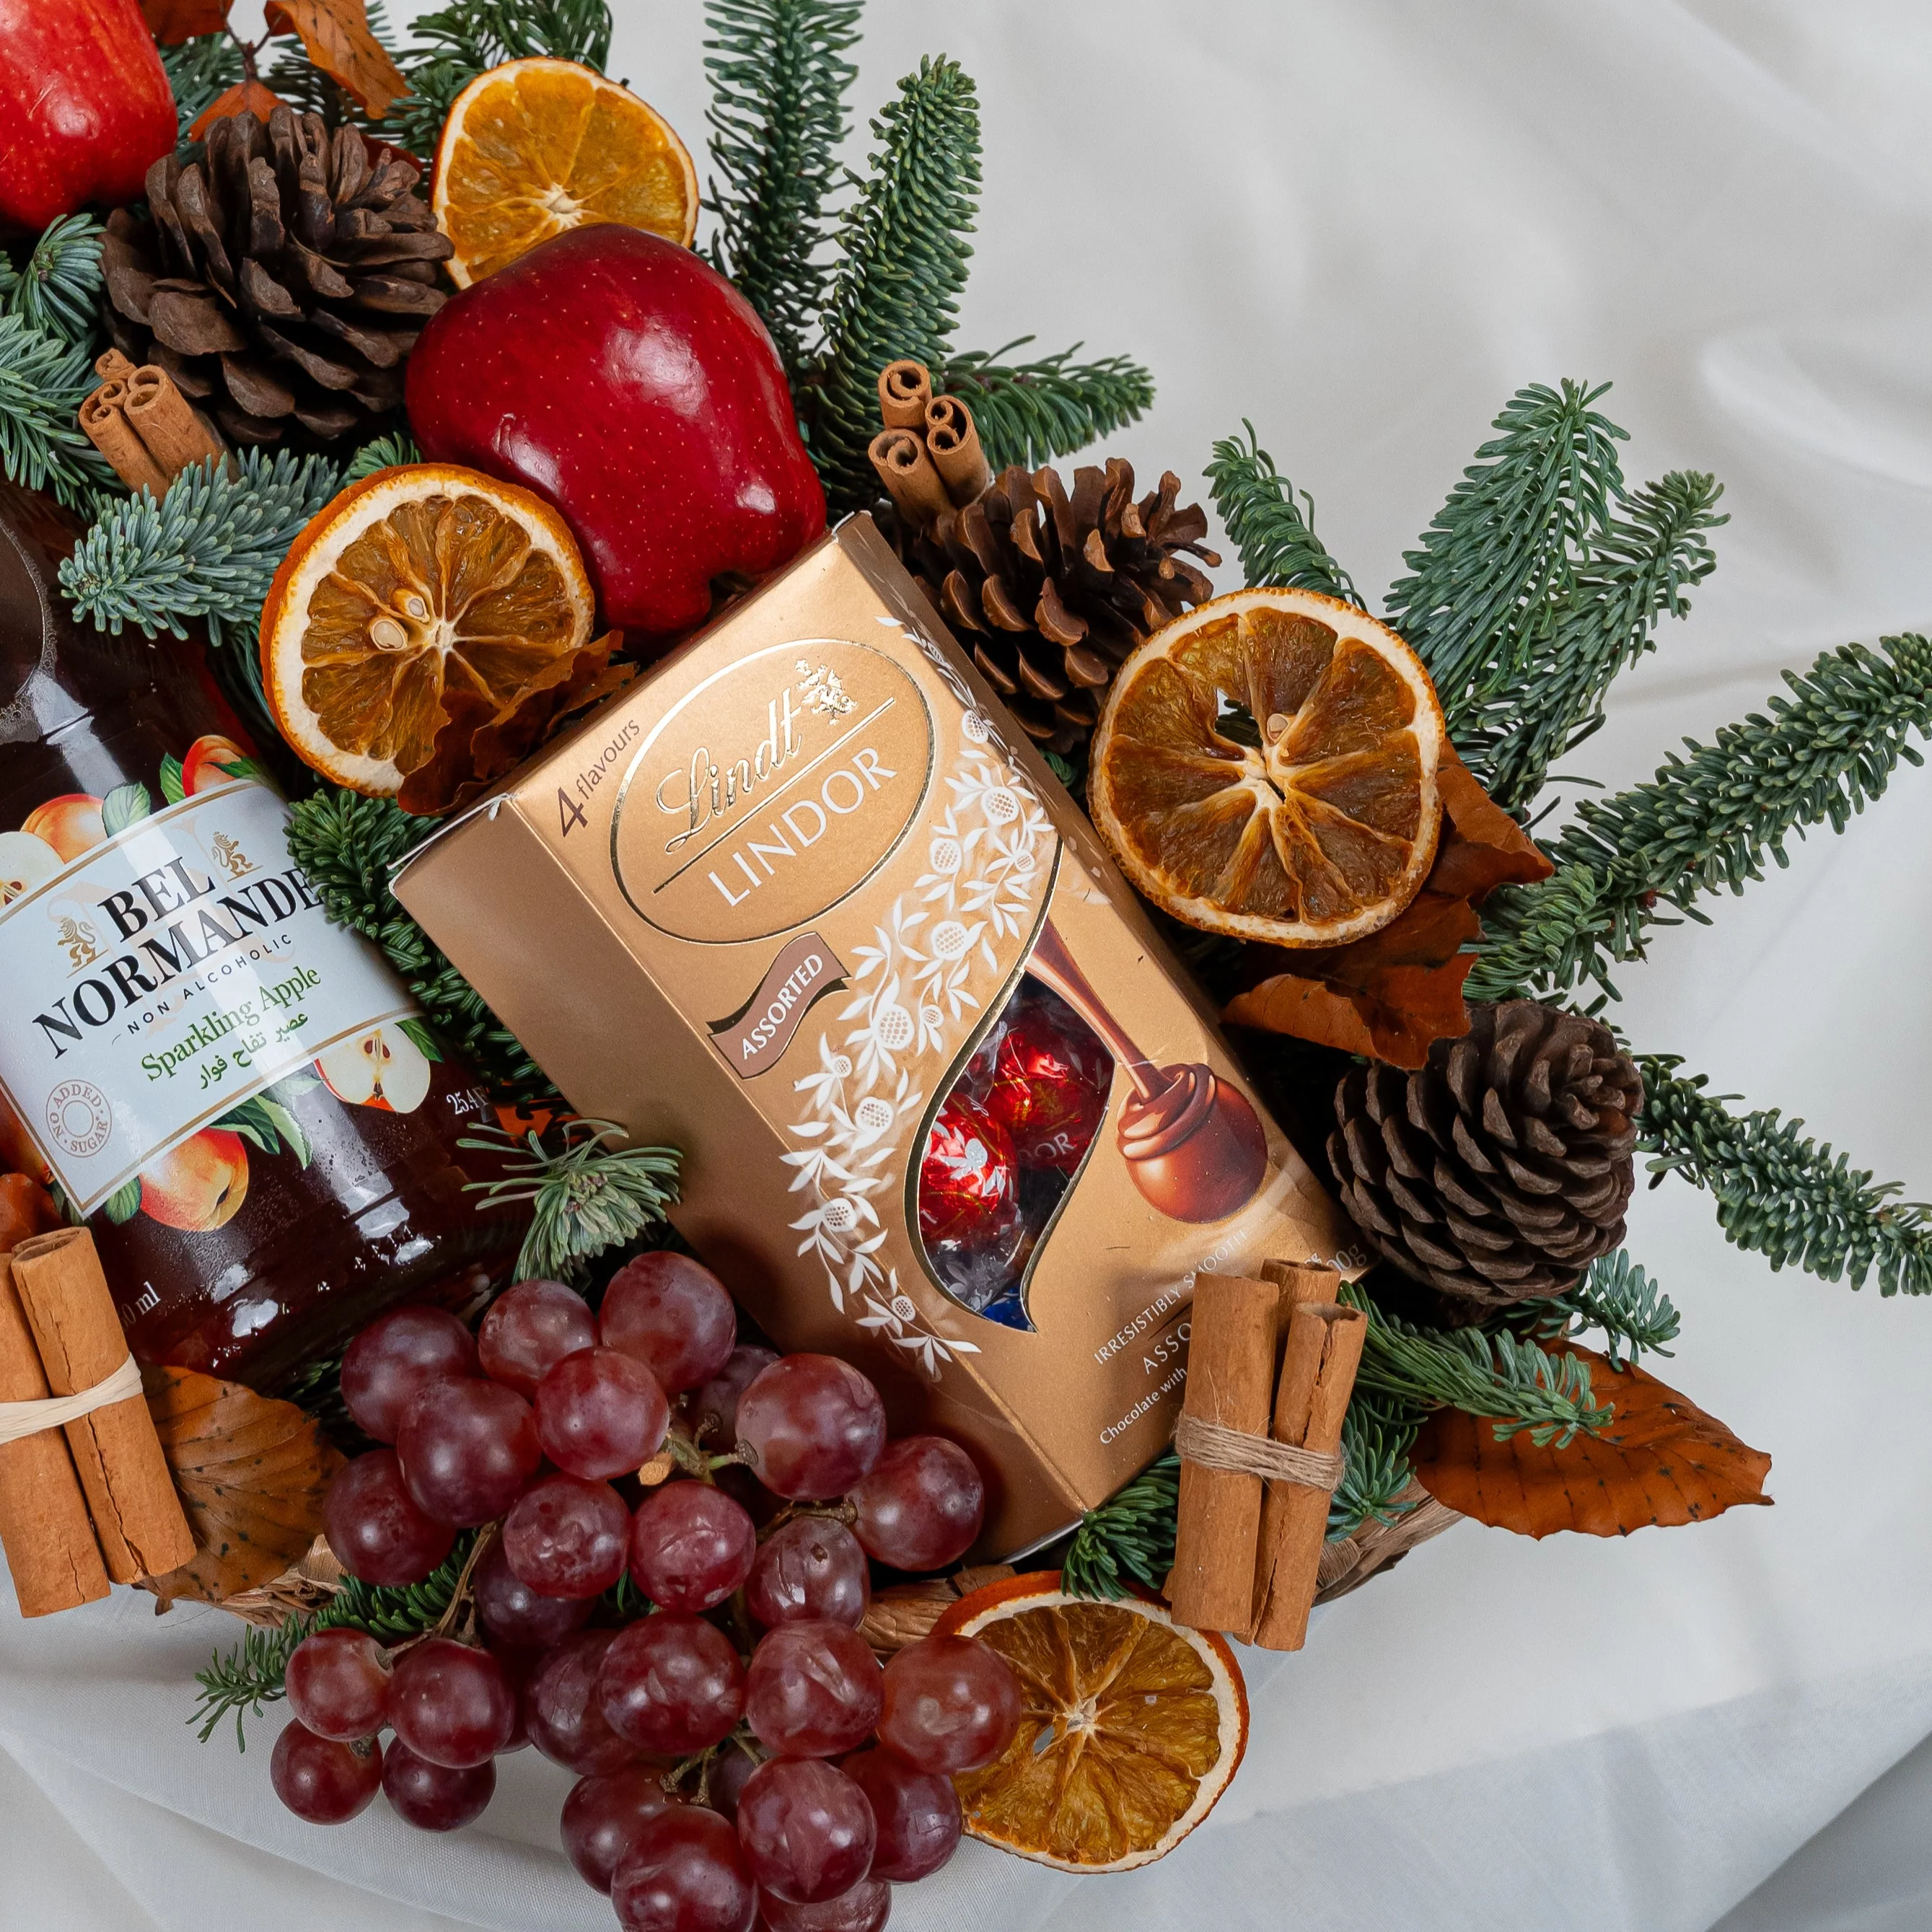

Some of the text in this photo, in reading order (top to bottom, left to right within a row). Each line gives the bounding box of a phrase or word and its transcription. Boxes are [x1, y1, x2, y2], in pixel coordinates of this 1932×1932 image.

[556, 719, 641, 838] 4 flavours
[655, 688, 802, 853] Lindt
[707, 747, 898, 908] LINDOR
[97, 856, 216, 943] BEL
[32, 867, 325, 1059] NORMANDE
[127, 934, 291, 1035] NON ALCOHOLIC
[741, 954, 824, 1061] ASSORTED
[141, 965, 321, 1082] Sparkling Apple
[200, 1013, 309, 1090] عصير تفاح فوار
[50, 1084, 108, 1153] NO ADDED SUGAR
[135, 1281, 161, 1316] ml
[1094, 1285, 1181, 1365] IRRESISTIBLY
[1099, 1368, 1187, 1444] Chocolate with
